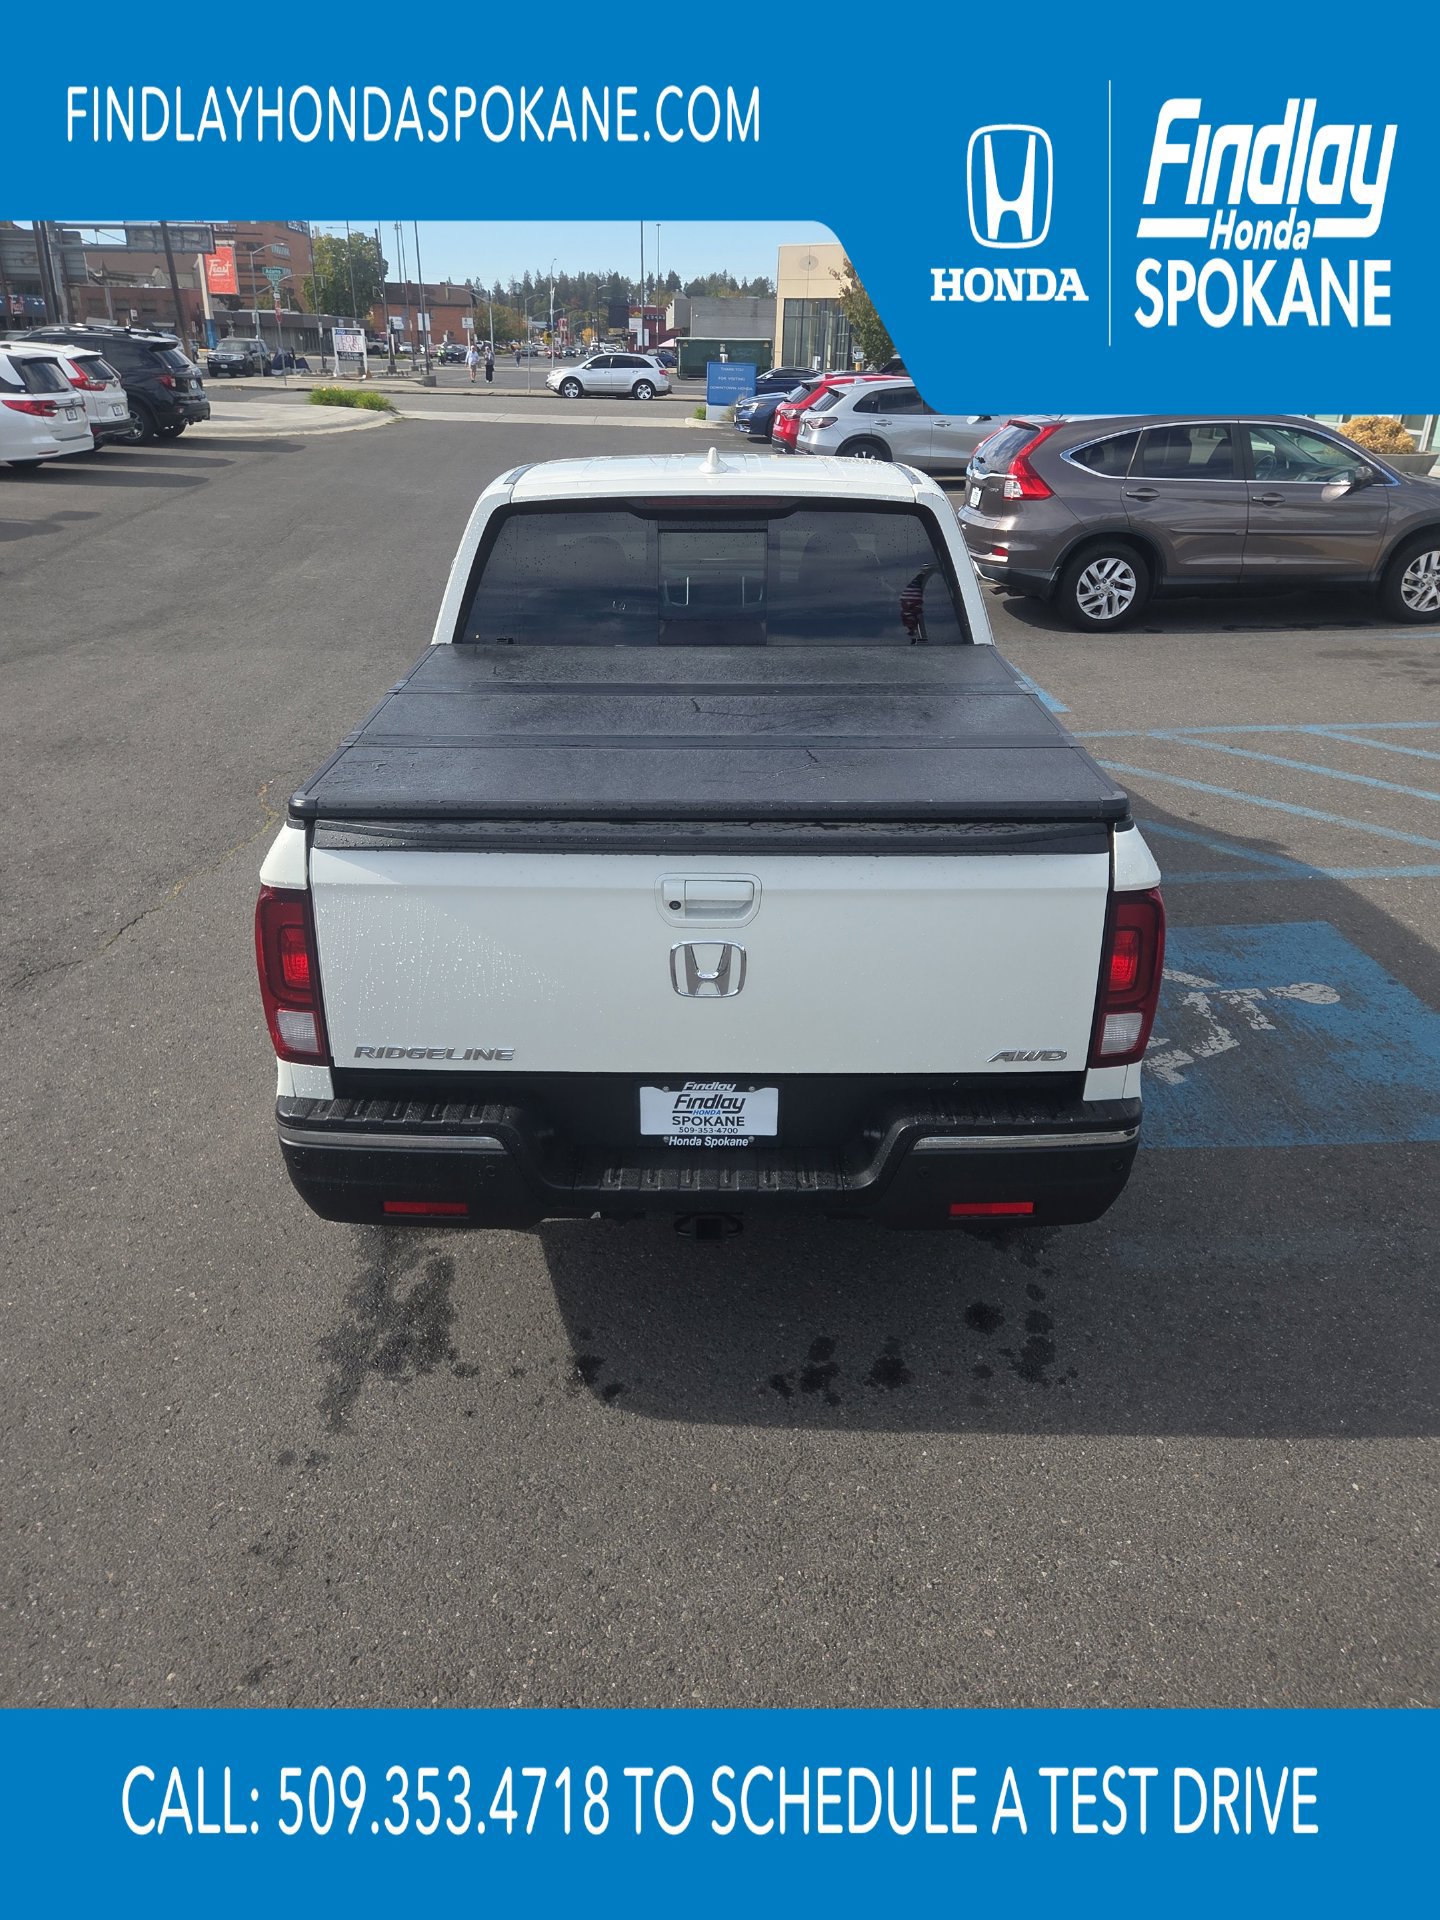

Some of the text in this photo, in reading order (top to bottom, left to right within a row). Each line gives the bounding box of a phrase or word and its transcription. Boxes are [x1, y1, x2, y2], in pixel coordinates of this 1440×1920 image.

[208, 259, 232, 276] Feast
[341, 335, 358, 344] FOR
[337, 343, 363, 351] LEASE
[353, 1045, 516, 1061] RIDGELINE
[986, 1049, 1068, 1063] AWD
[682, 1081, 737, 1092] Findlay
[672, 1093, 746, 1114] Findlay
[672, 1116, 745, 1127] SPOKANE
[678, 1126, 739, 1134] 509-353-4700
[668, 1136, 749, 1148] Honda Spokane
